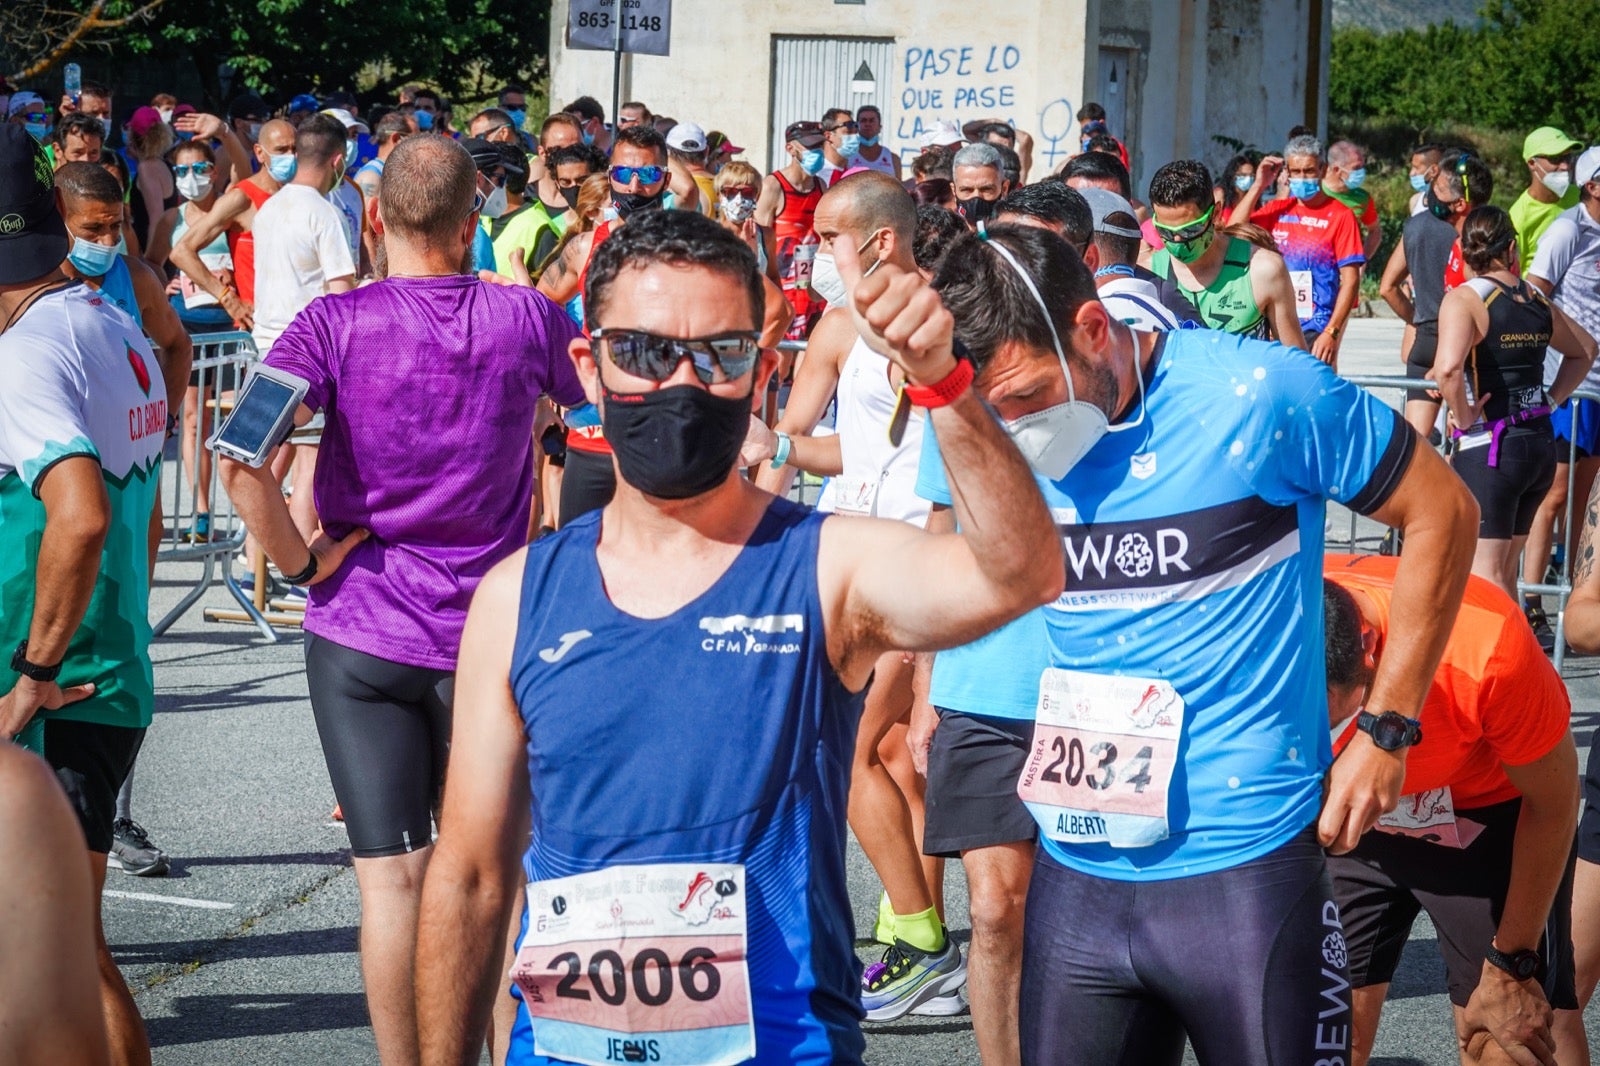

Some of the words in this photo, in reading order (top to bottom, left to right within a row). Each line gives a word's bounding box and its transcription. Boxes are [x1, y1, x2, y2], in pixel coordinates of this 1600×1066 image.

[904, 46, 975, 83] PASE
[985, 45, 1020, 73] LO
[901, 87, 943, 110] QUE
[954, 86, 1015, 109] PASE
[897, 116, 923, 139] LA
[1301, 215, 1329, 229] SEUR
[1500, 333, 1534, 342] GRANADA
[701, 638, 741, 654] CFM
[752, 643, 801, 654] GRANADA
[1023, 746, 1044, 788] MASTER
[1040, 735, 1153, 794] 2034
[546, 946, 721, 1007] 2006
